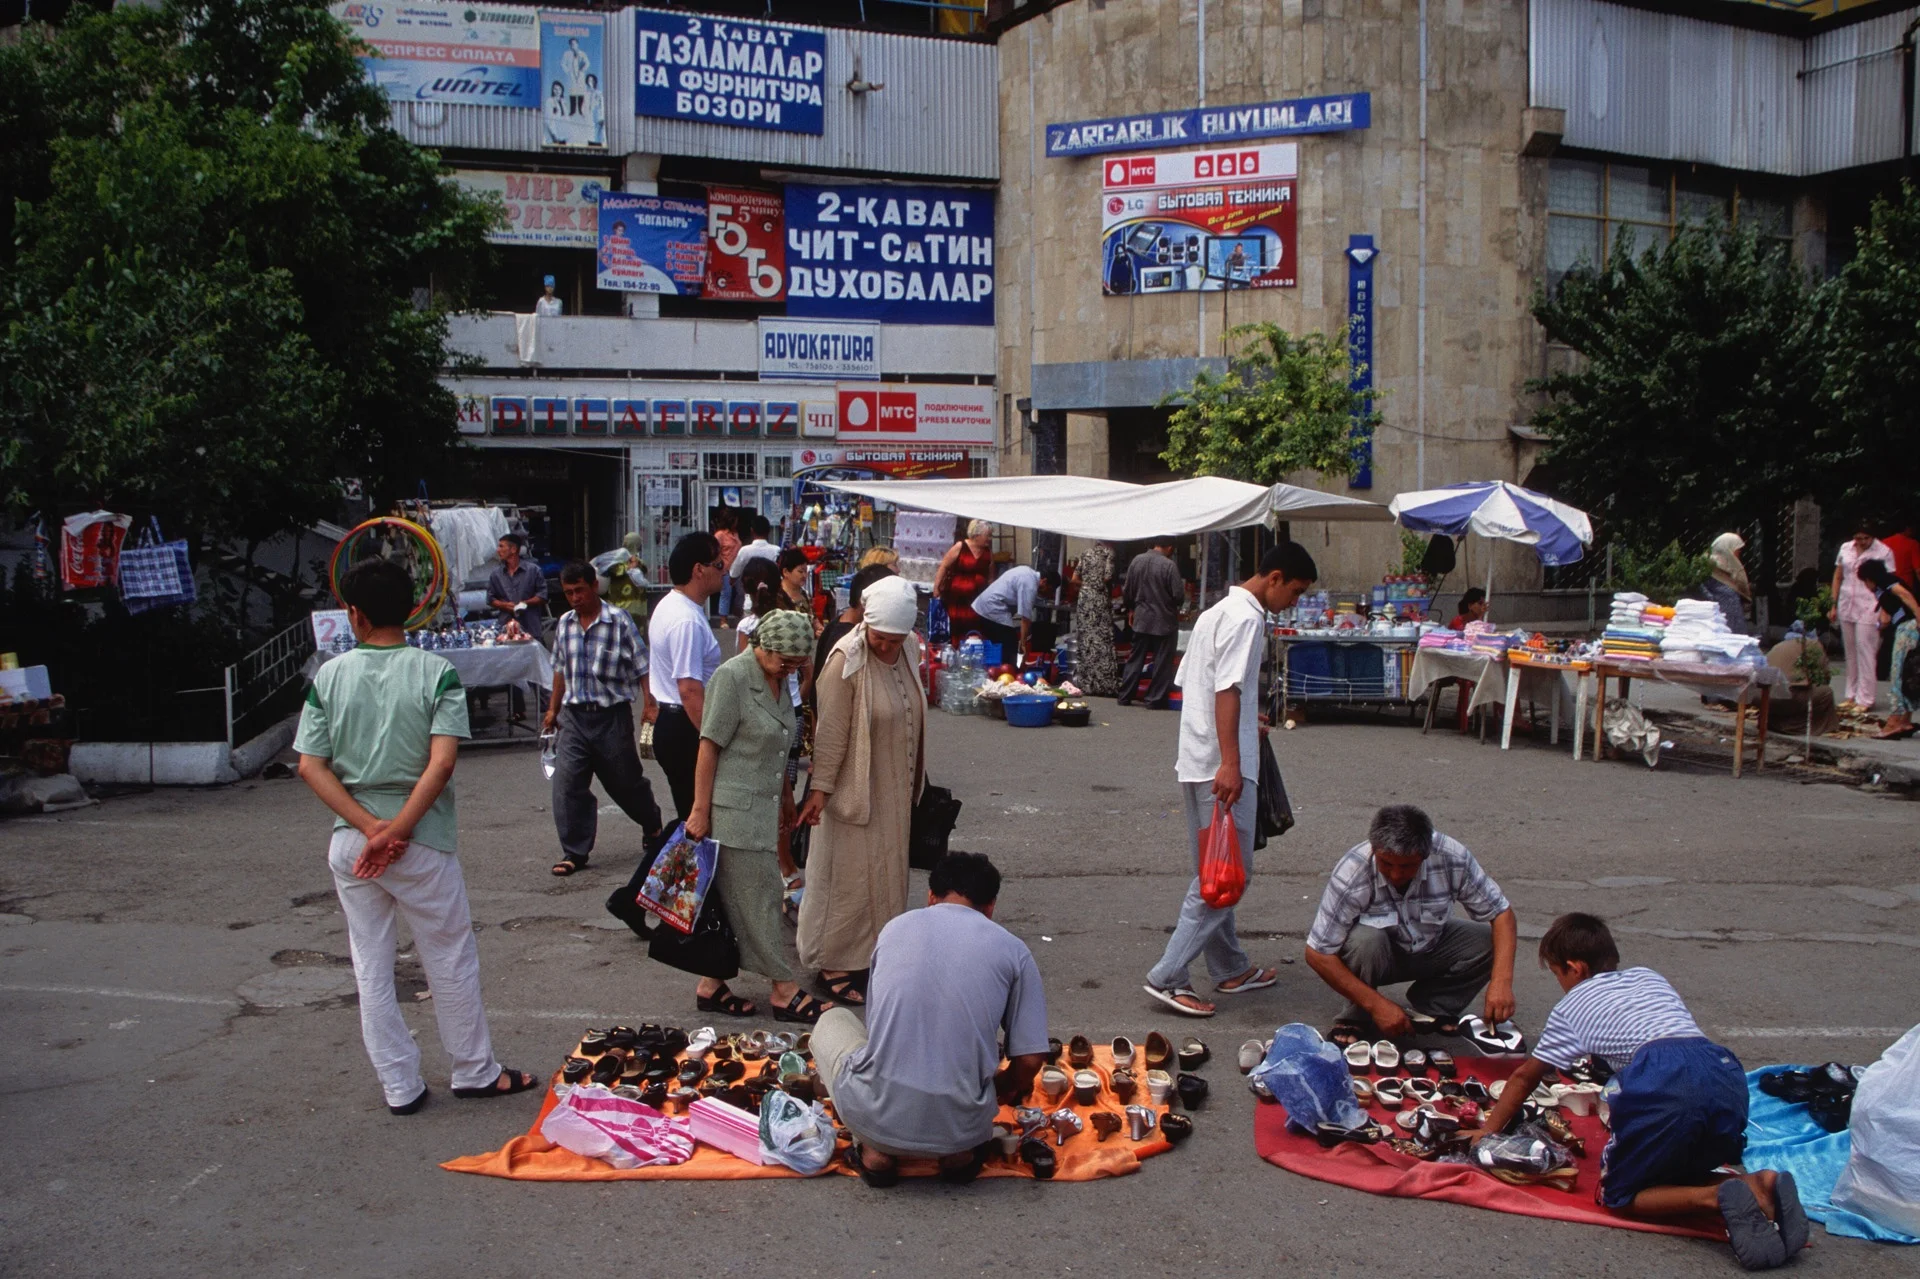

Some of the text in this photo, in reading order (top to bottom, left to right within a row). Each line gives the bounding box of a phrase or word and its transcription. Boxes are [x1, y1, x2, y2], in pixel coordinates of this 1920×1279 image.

[687, 18, 702, 34] 2
[451, 48, 516, 63] ОПЛАТА
[639, 64, 823, 107] ВА ФУРНИТУРА
[676, 92, 781, 124] БОЗОРИ
[1050, 99, 1353, 151] ZARGARLIK BUYUMLARI
[1131, 166, 1154, 176] МТС
[505, 175, 574, 202] МИР
[1128, 199, 1144, 210] LG
[1158, 186, 1290, 210] БЫТОВАЯ ТЕХНИКА
[504, 203, 598, 232] РЯЖИ
[738, 206, 751, 223] 5
[787, 266, 993, 303] ДУХОБАЛАР
[765, 332, 873, 362] ADVOKATURA
[880, 406, 915, 420] МТС
[924, 403, 985, 413] ПОДКЛЮЧЕНИЕ
[807, 412, 833, 428] ЧП
[918, 416, 992, 425] X-PRESS КАРТОЧКИ
[818, 453, 833, 462] LG
[846, 451, 964, 462] БЫТОВАЯ ТЕХНИКА
[318, 617, 337, 642] 2
